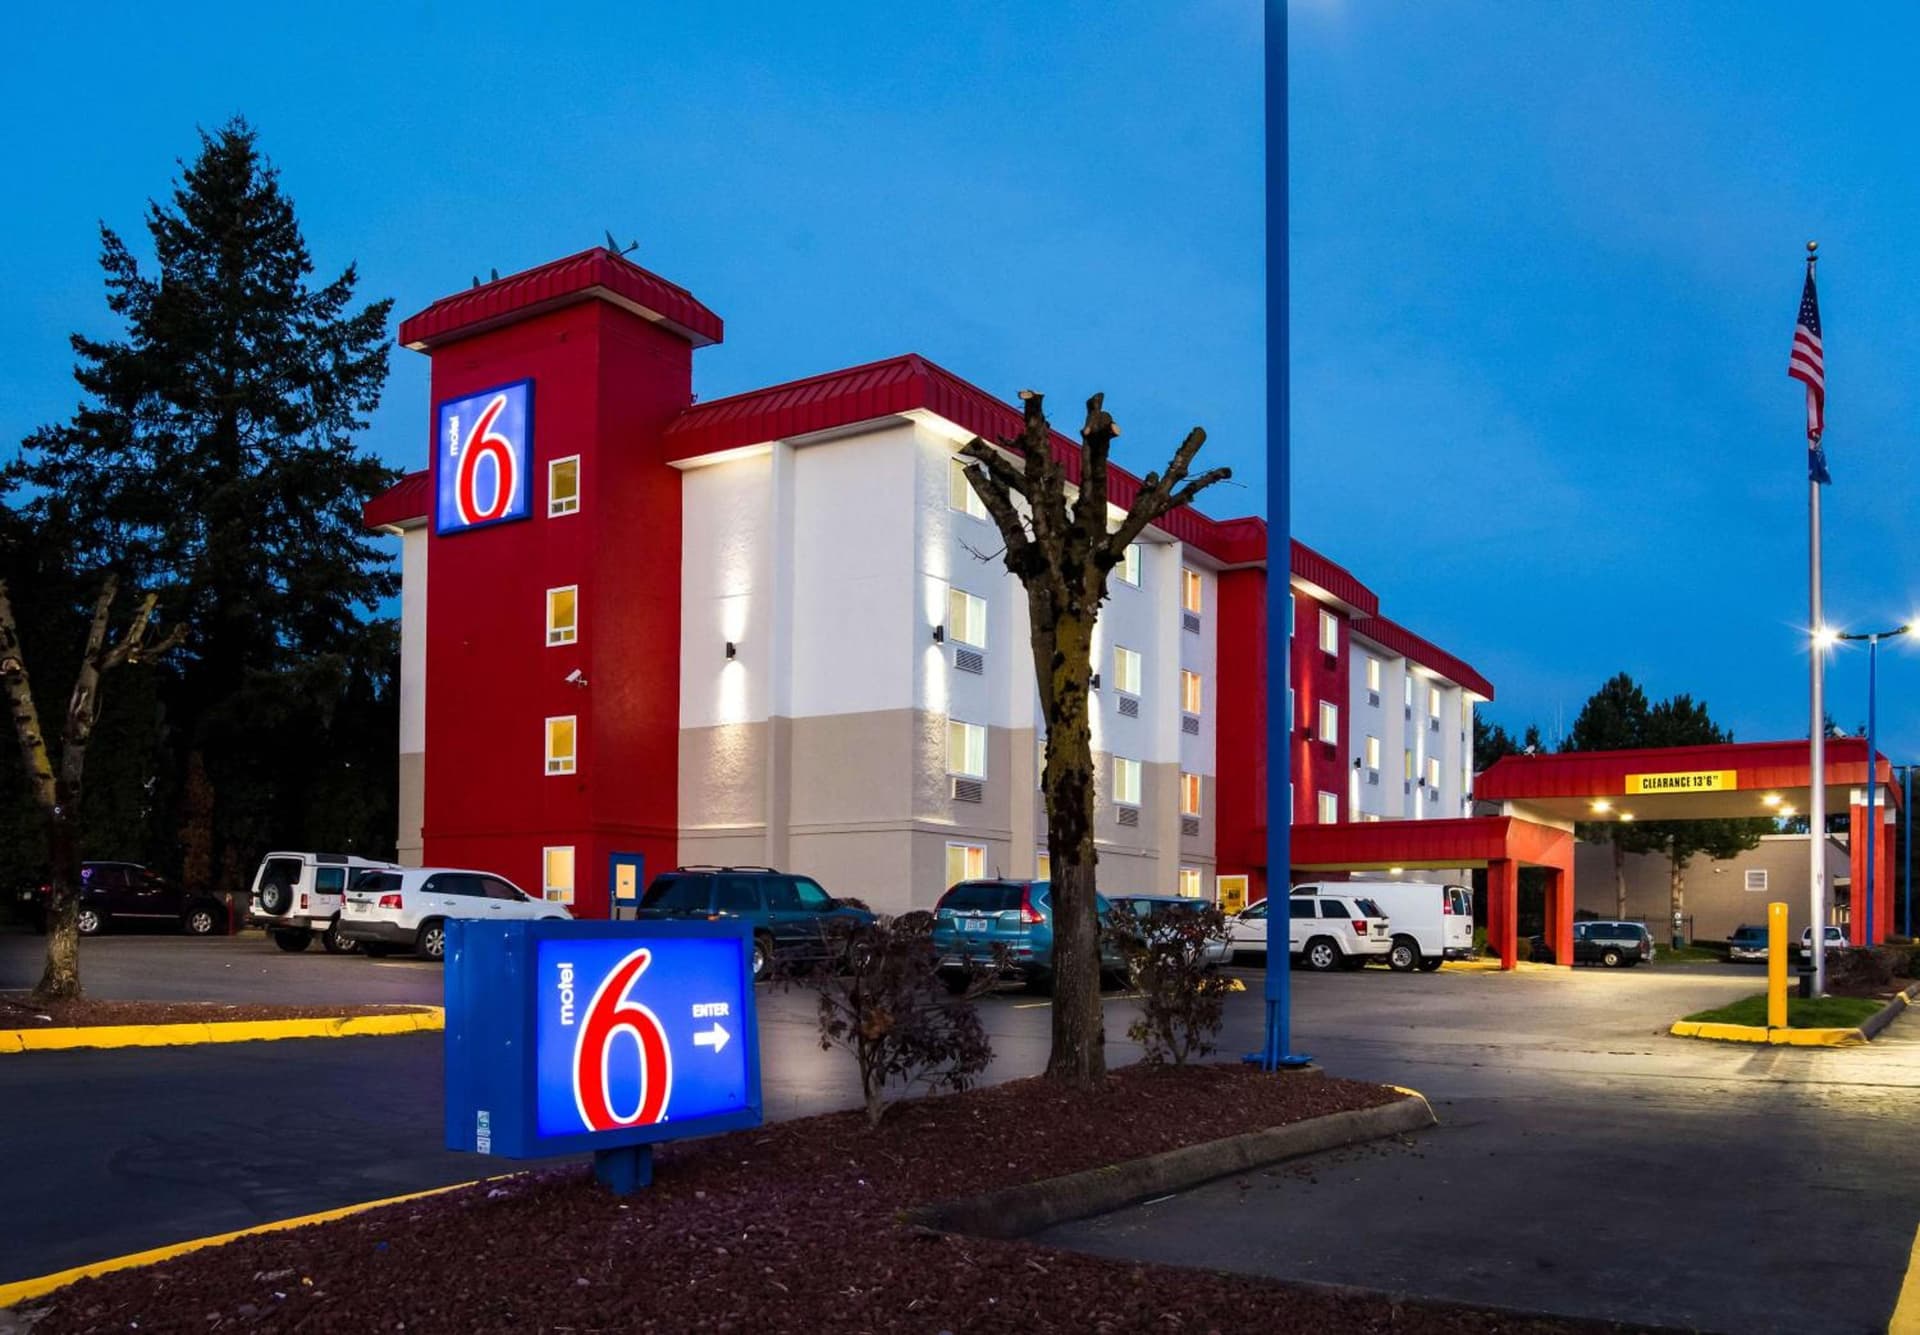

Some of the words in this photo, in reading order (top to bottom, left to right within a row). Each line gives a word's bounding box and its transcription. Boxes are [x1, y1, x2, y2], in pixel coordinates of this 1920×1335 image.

[449, 415, 459, 456] motel
[455, 394, 517, 525] 6
[1642, 776, 1690, 789] CLEARANCE
[557, 963, 574, 1025] motel
[573, 948, 673, 1132] 6
[692, 1002, 729, 1017] ENTER
